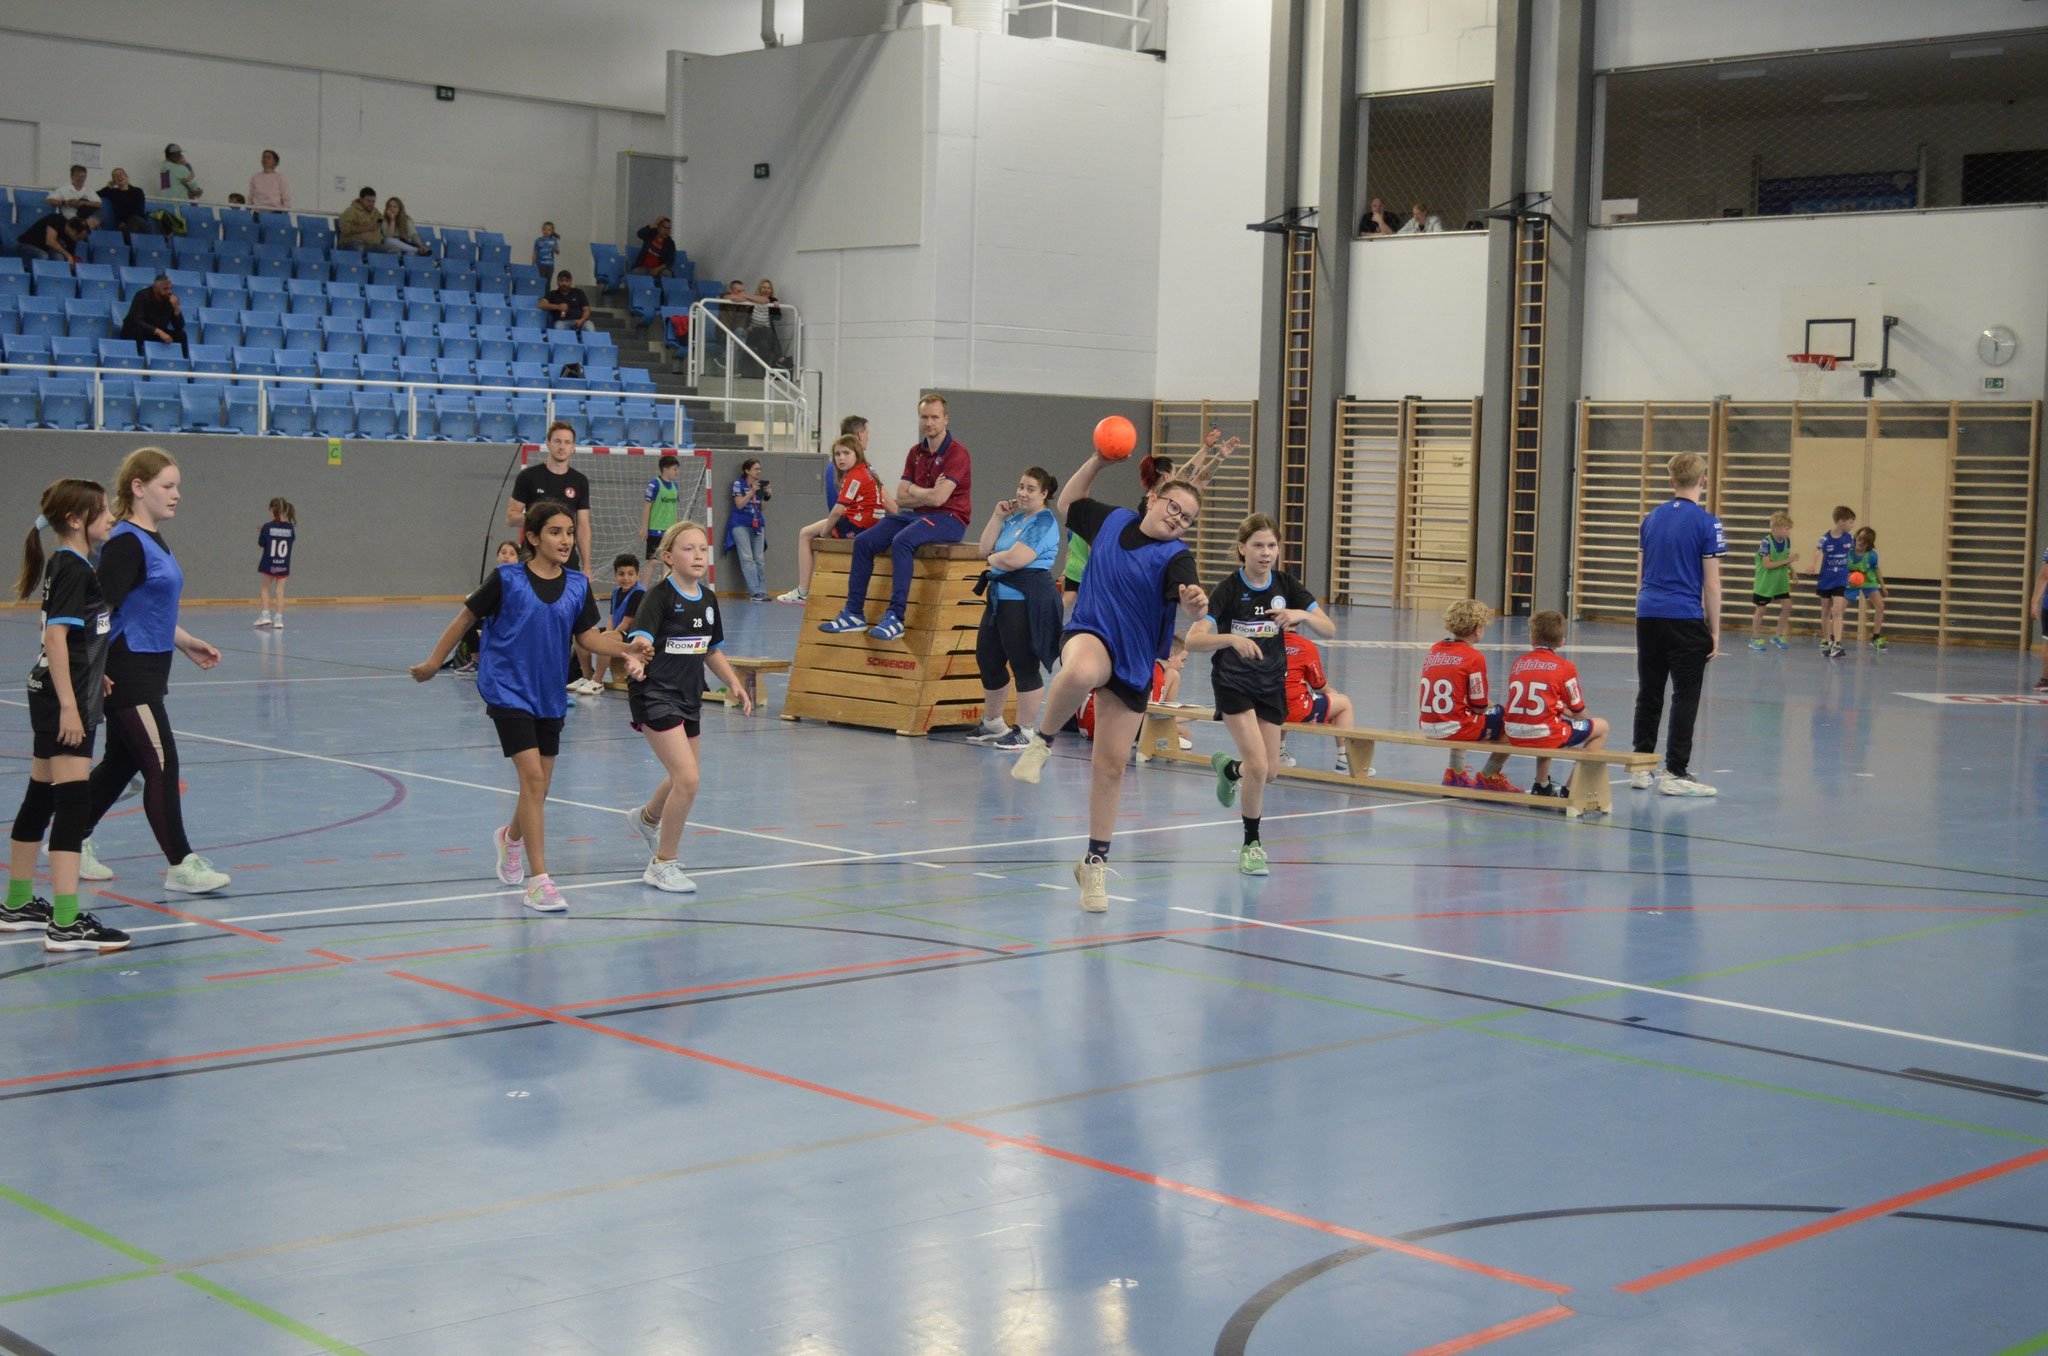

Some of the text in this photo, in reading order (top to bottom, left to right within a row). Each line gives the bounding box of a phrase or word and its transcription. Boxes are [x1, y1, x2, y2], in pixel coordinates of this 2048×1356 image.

[330, 447, 339, 459] C
[270, 539, 288, 558] 10
[1254, 606, 1265, 616] 21
[692, 618, 703, 628] 28
[1420, 677, 1454, 715] 28
[1508, 680, 1548, 716] 25
